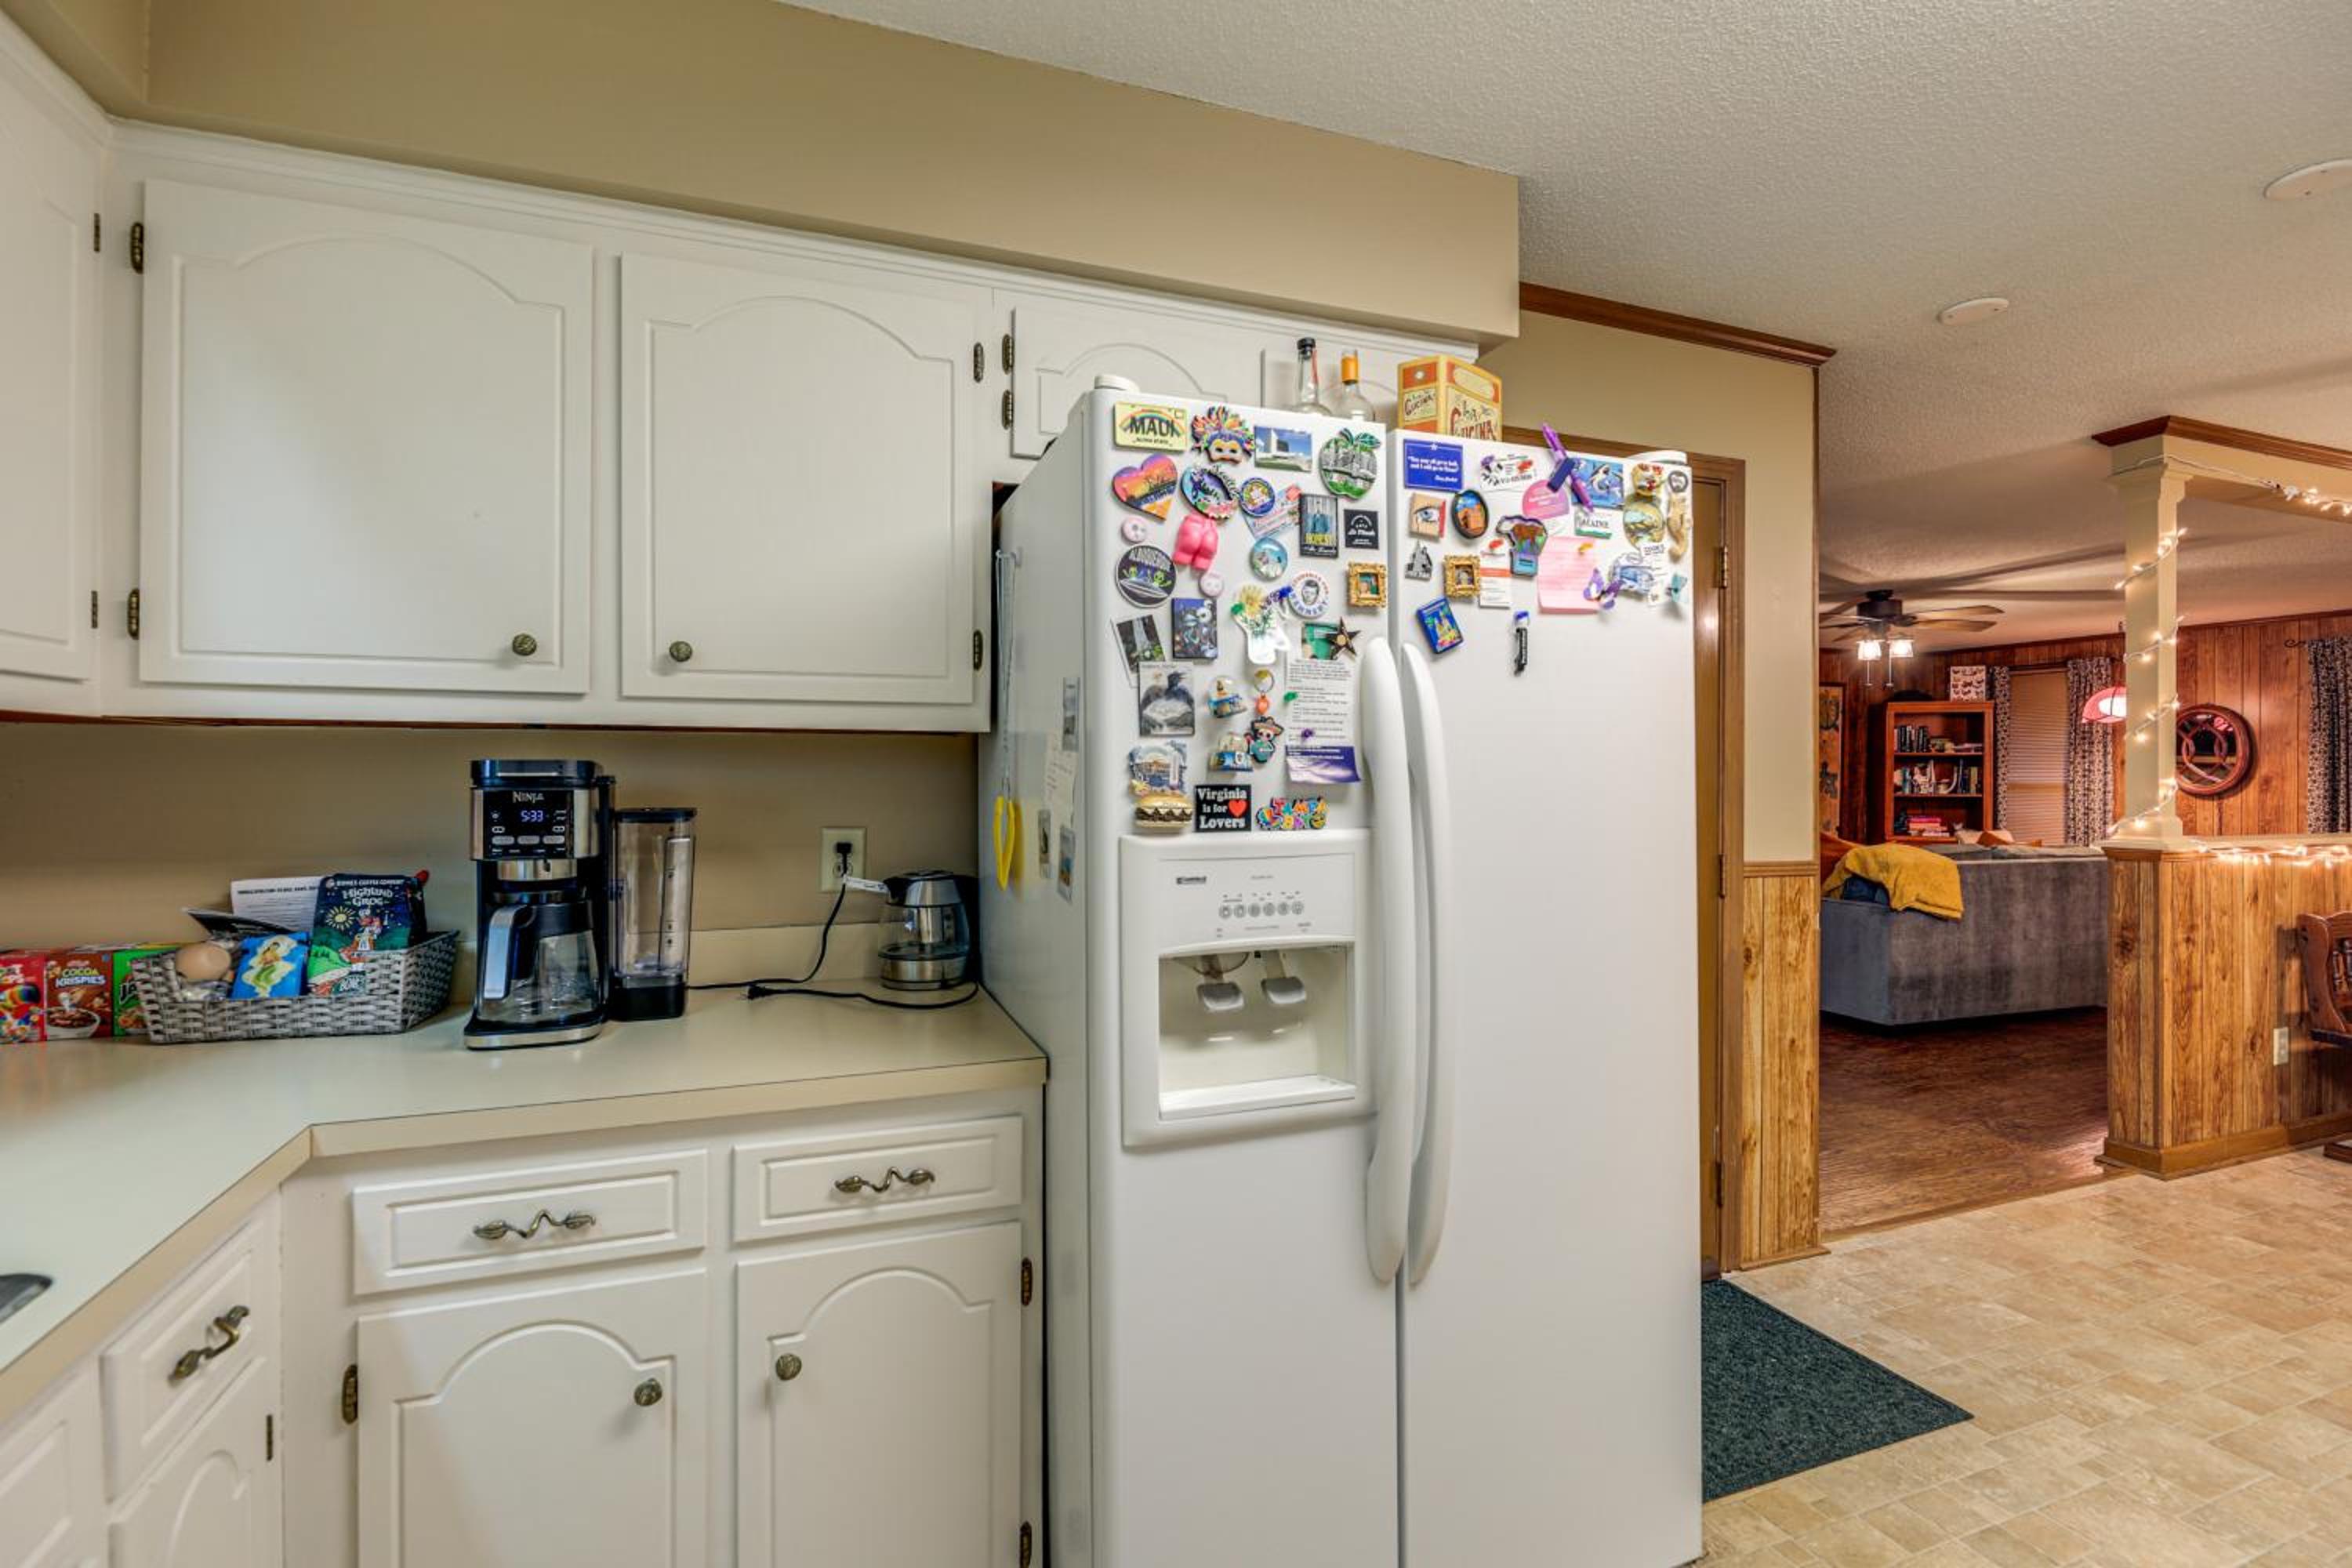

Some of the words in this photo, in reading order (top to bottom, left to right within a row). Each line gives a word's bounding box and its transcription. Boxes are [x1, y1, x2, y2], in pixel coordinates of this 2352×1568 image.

[512, 790, 545, 804] NINJA
[1196, 787, 1247, 802] Virginia
[520, 809, 544, 822] 5:33
[1202, 804, 1211, 813] is
[1213, 804, 1228, 813] for
[1199, 815, 1246, 829] Lovers
[62, 967, 100, 978] COCOA
[55, 975, 106, 989] KRISPIES
